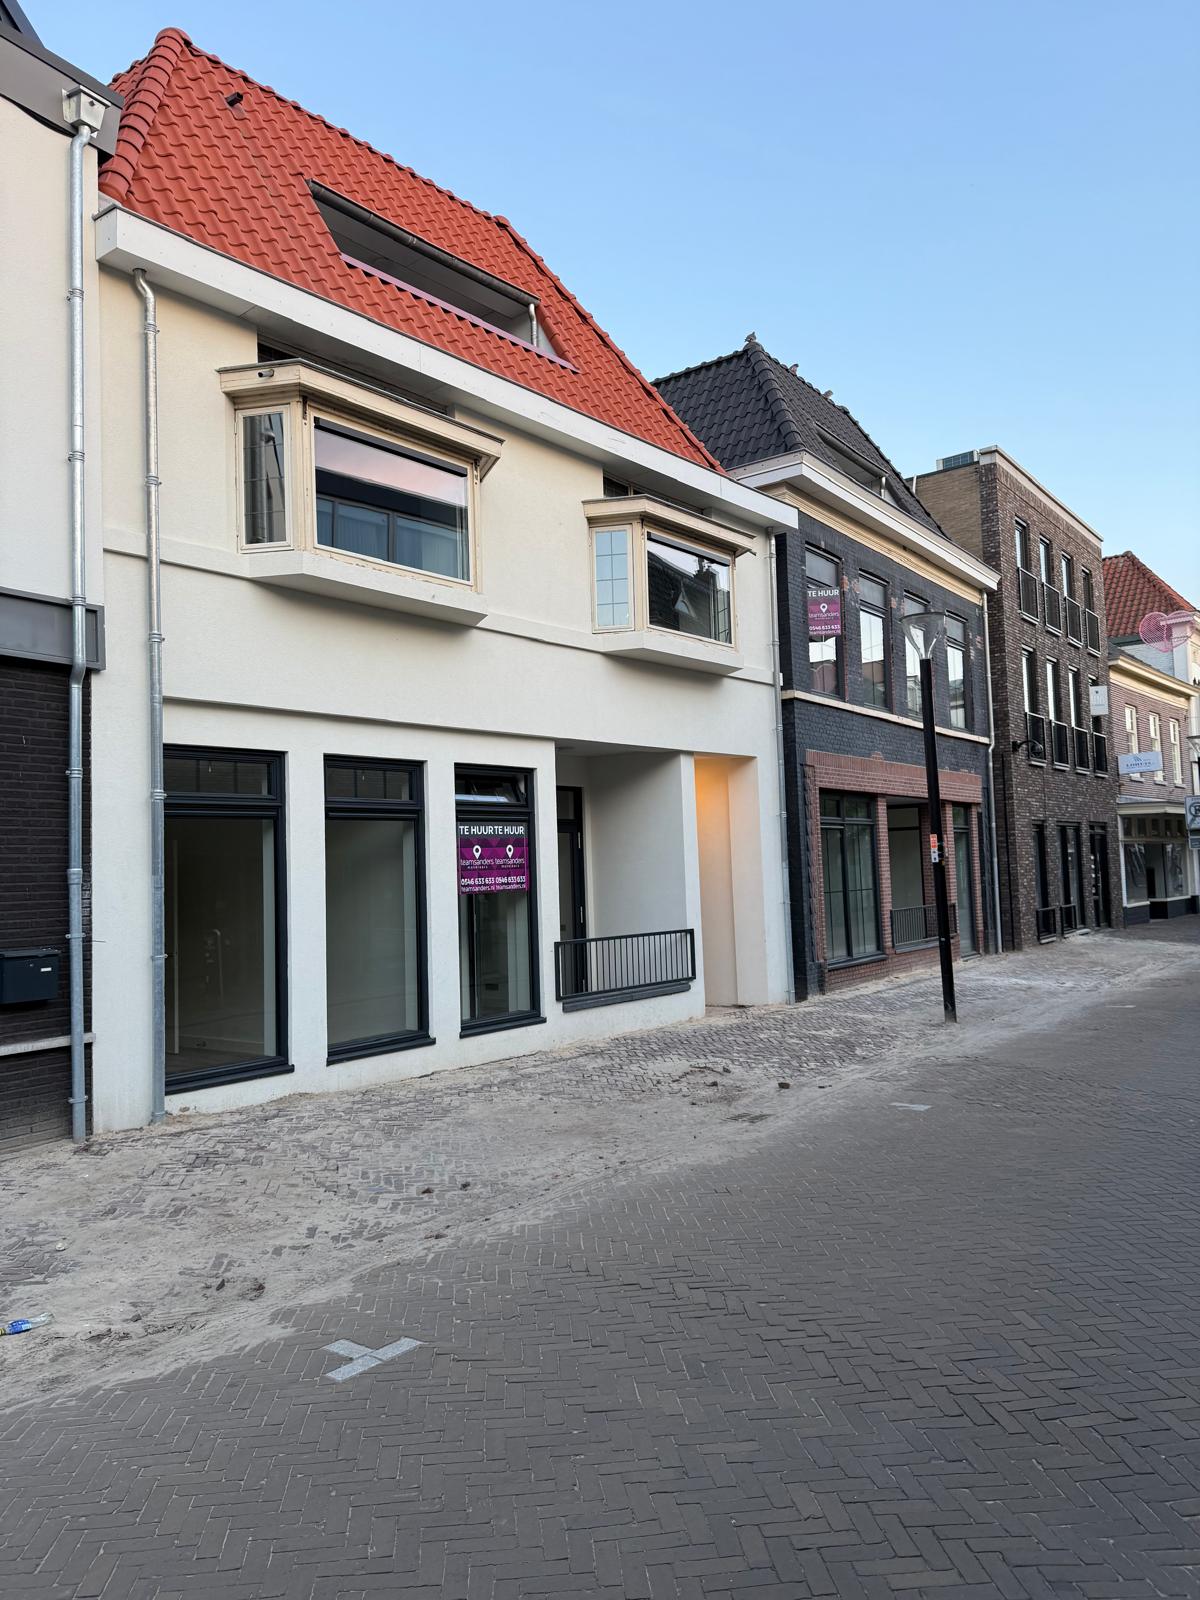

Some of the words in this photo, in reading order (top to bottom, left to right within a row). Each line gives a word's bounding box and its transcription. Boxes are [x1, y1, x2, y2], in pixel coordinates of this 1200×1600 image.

[818, 589, 839, 597] HUUR
[459, 825, 469, 835] TE
[471, 825, 494, 835] HUUR
[494, 825, 503, 835] TE
[504, 825, 525, 835] HUUR
[460, 858, 494, 866] teamsanders
[461, 878, 474, 886] 0546
[496, 876, 508, 884] 0546
[517, 875, 526, 883] 633
